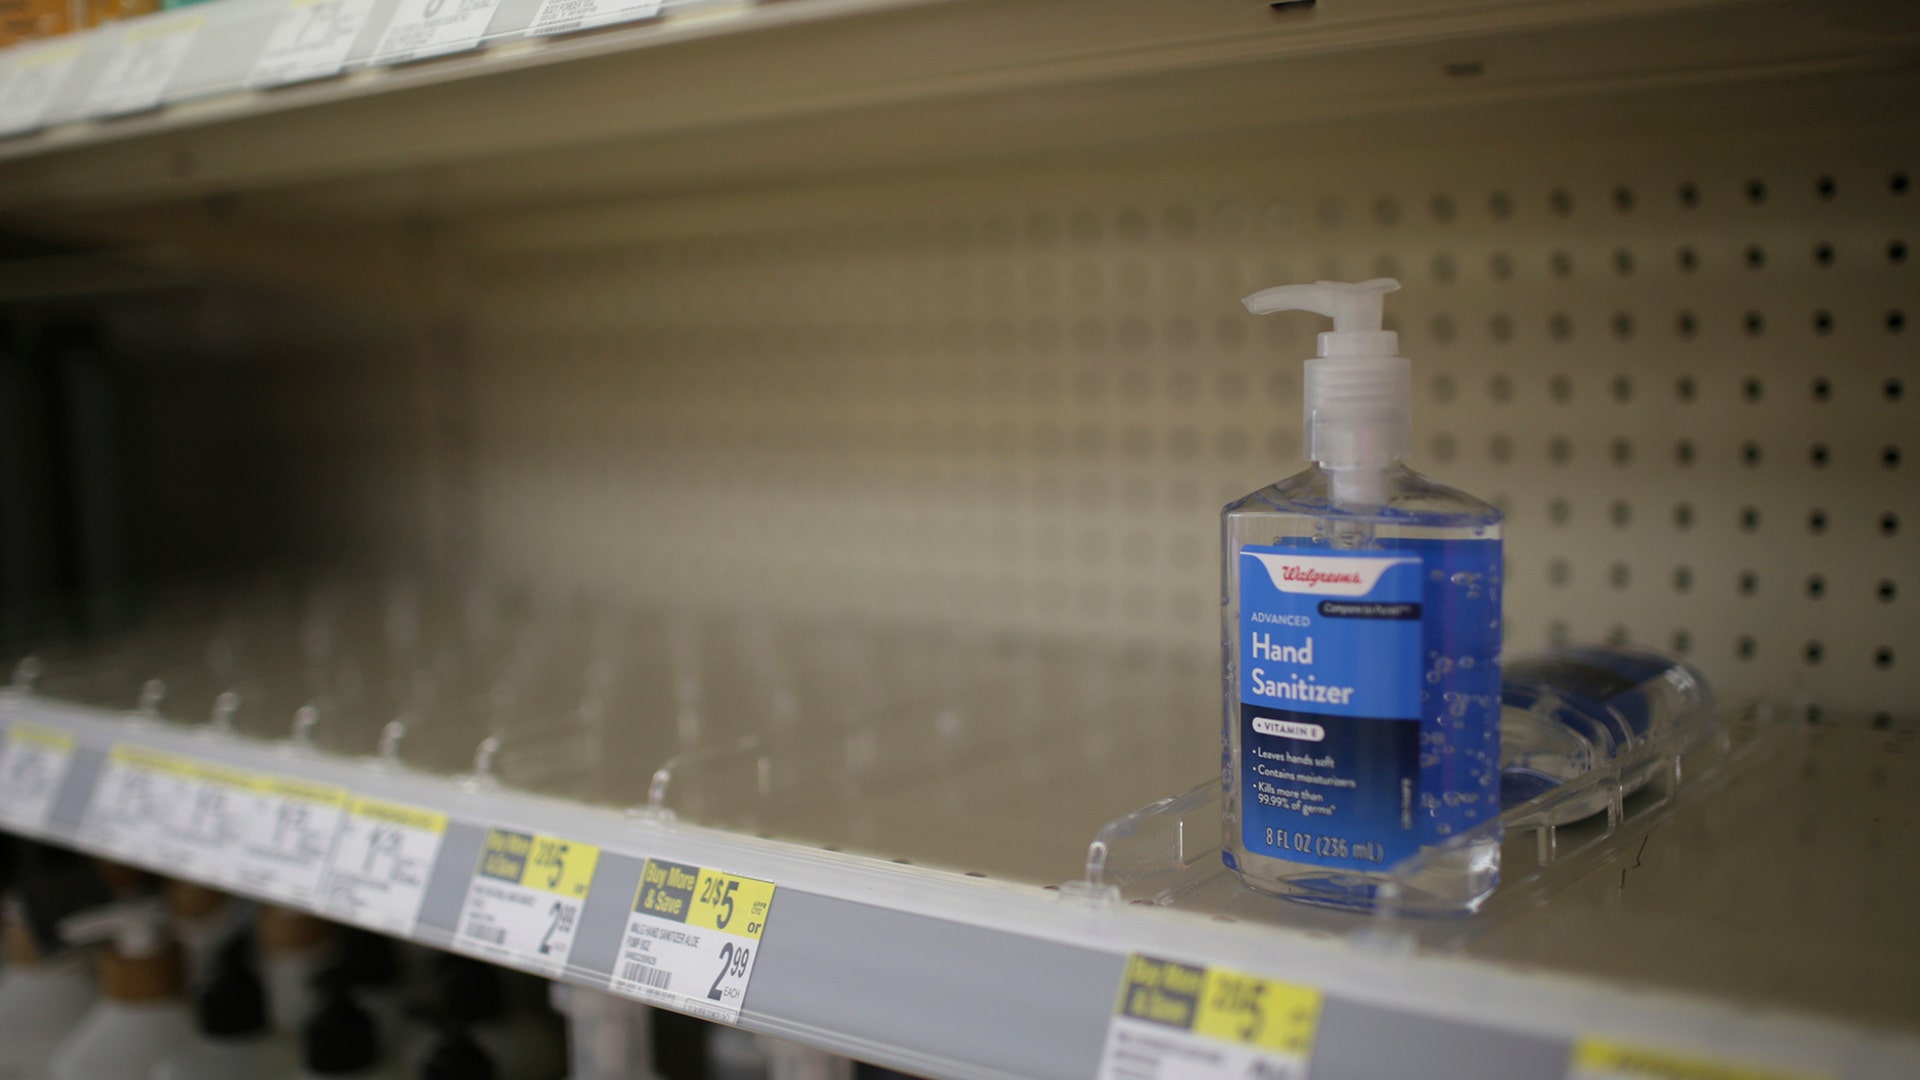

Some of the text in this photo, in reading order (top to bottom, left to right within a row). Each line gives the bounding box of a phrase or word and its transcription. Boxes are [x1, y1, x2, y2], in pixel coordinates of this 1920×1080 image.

[1282, 566, 1362, 587] Walgreens
[1251, 612, 1311, 627] ADVANCED
[1252, 632, 1313, 664] Hand
[1252, 668, 1354, 704] Sanitizer
[1265, 722, 1308, 735] VITAMIN
[1258, 747, 1335, 768] Leaves hands soft
[1258, 764, 1357, 788] Contains moisturizers
[1258, 781, 1324, 802] Kills more than
[1258, 794, 1290, 809] 99.99%
[1291, 801, 1302, 811] of
[1266, 827, 1385, 864] 8 FL OZ (236 mL)
[645, 863, 695, 891] Buy More
[644, 888, 683, 915] & Save
[700, 876, 739, 929] 2/$5
[747, 921, 761, 935] or
[723, 986, 740, 999] EACH
